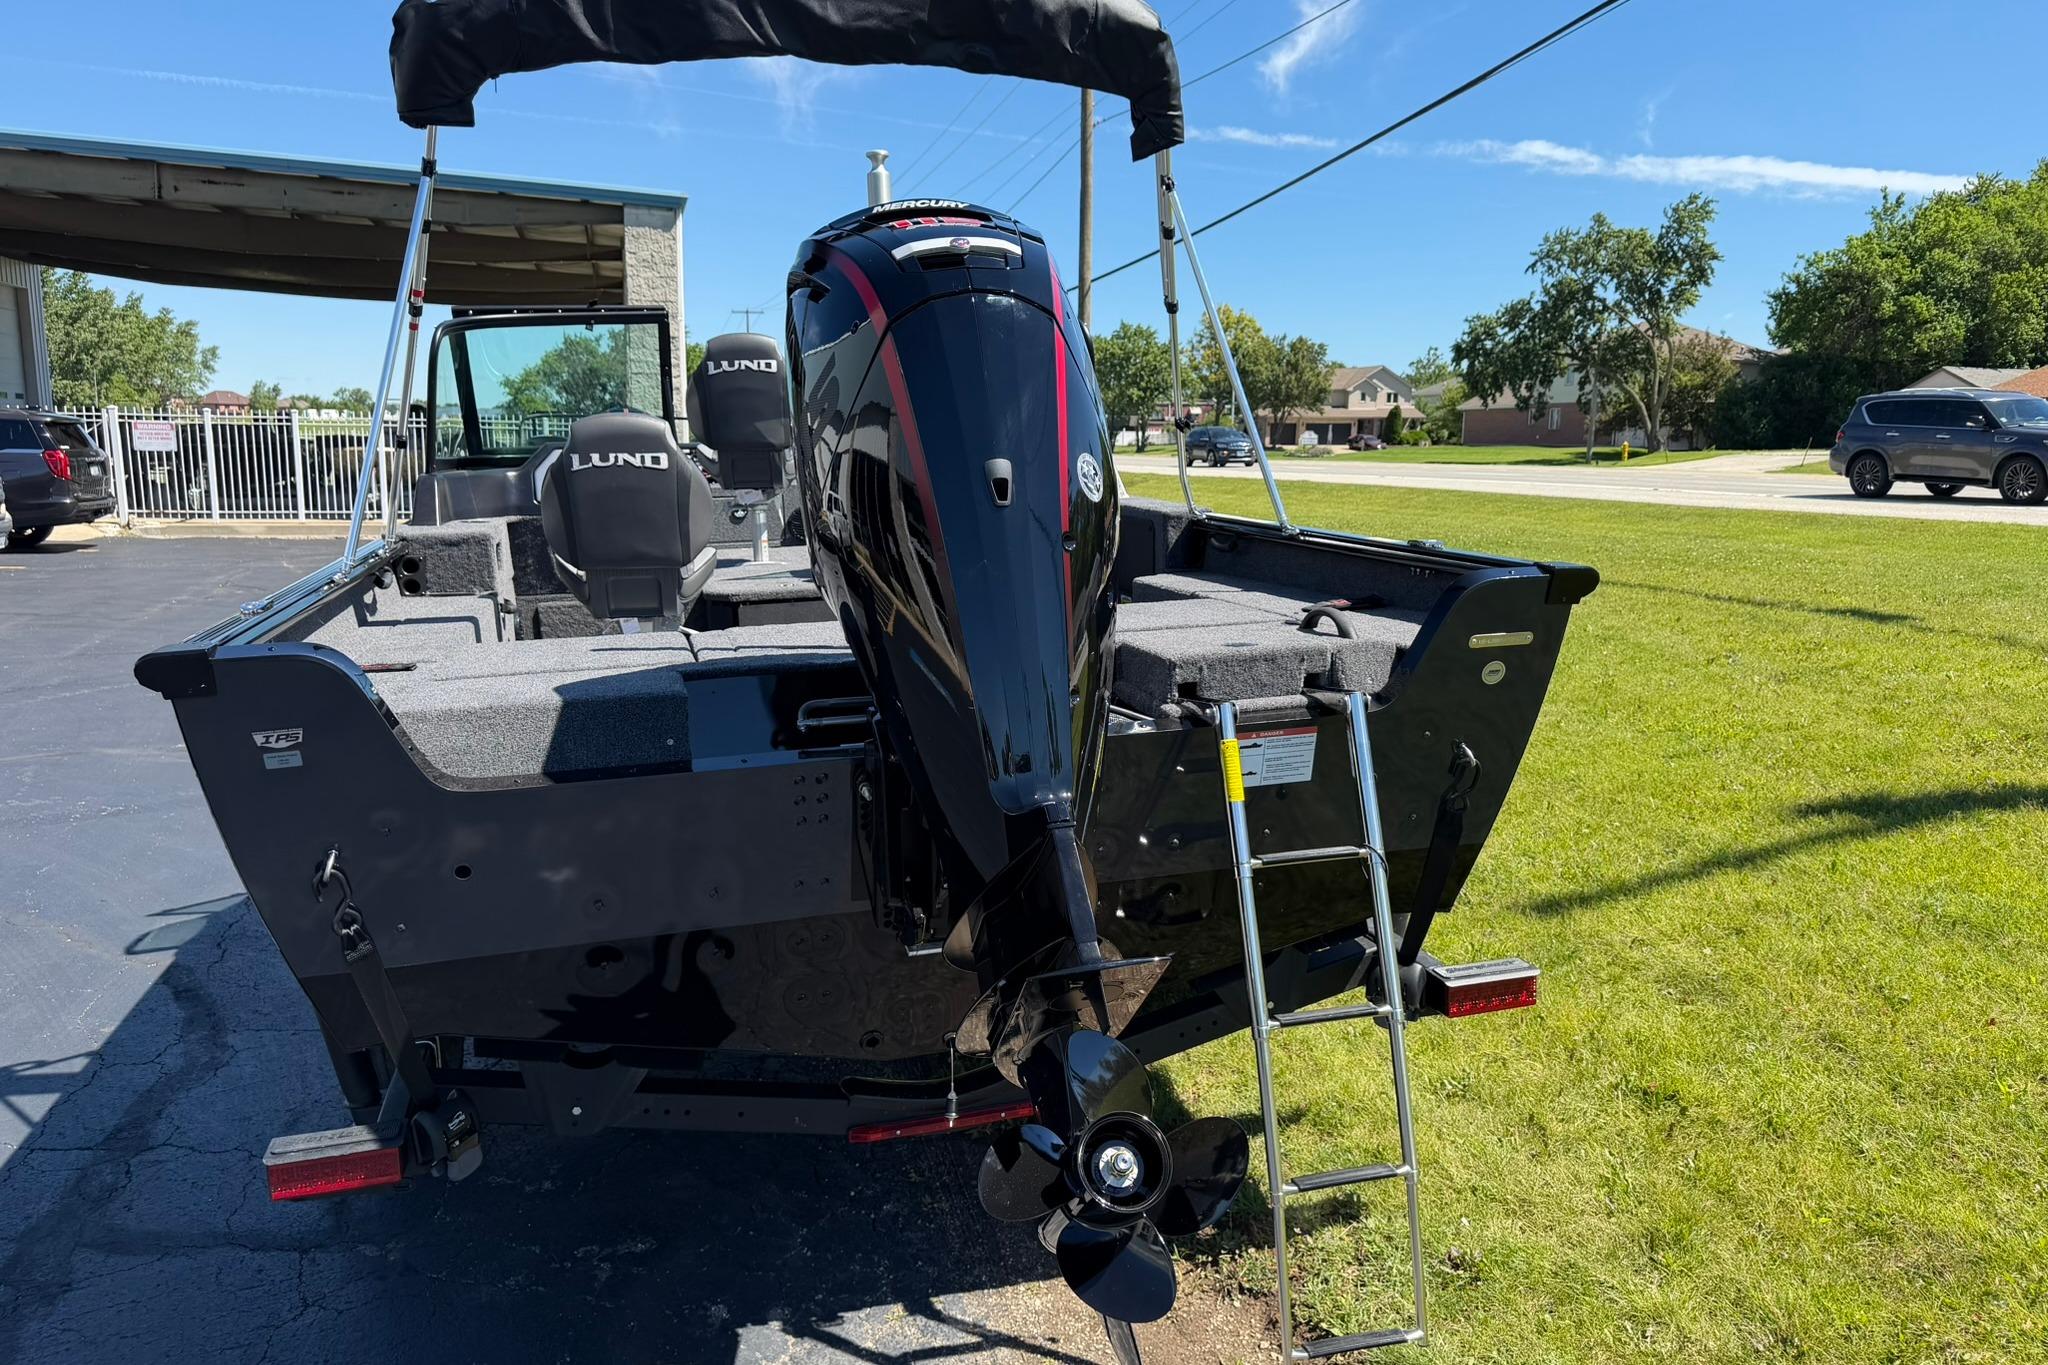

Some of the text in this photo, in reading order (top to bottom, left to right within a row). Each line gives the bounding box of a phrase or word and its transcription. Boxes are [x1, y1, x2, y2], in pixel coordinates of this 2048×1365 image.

[872, 200, 970, 213] MERCURY
[707, 359, 778, 375] LUND
[570, 452, 669, 472] LUND
[260, 732, 301, 745] IPS
